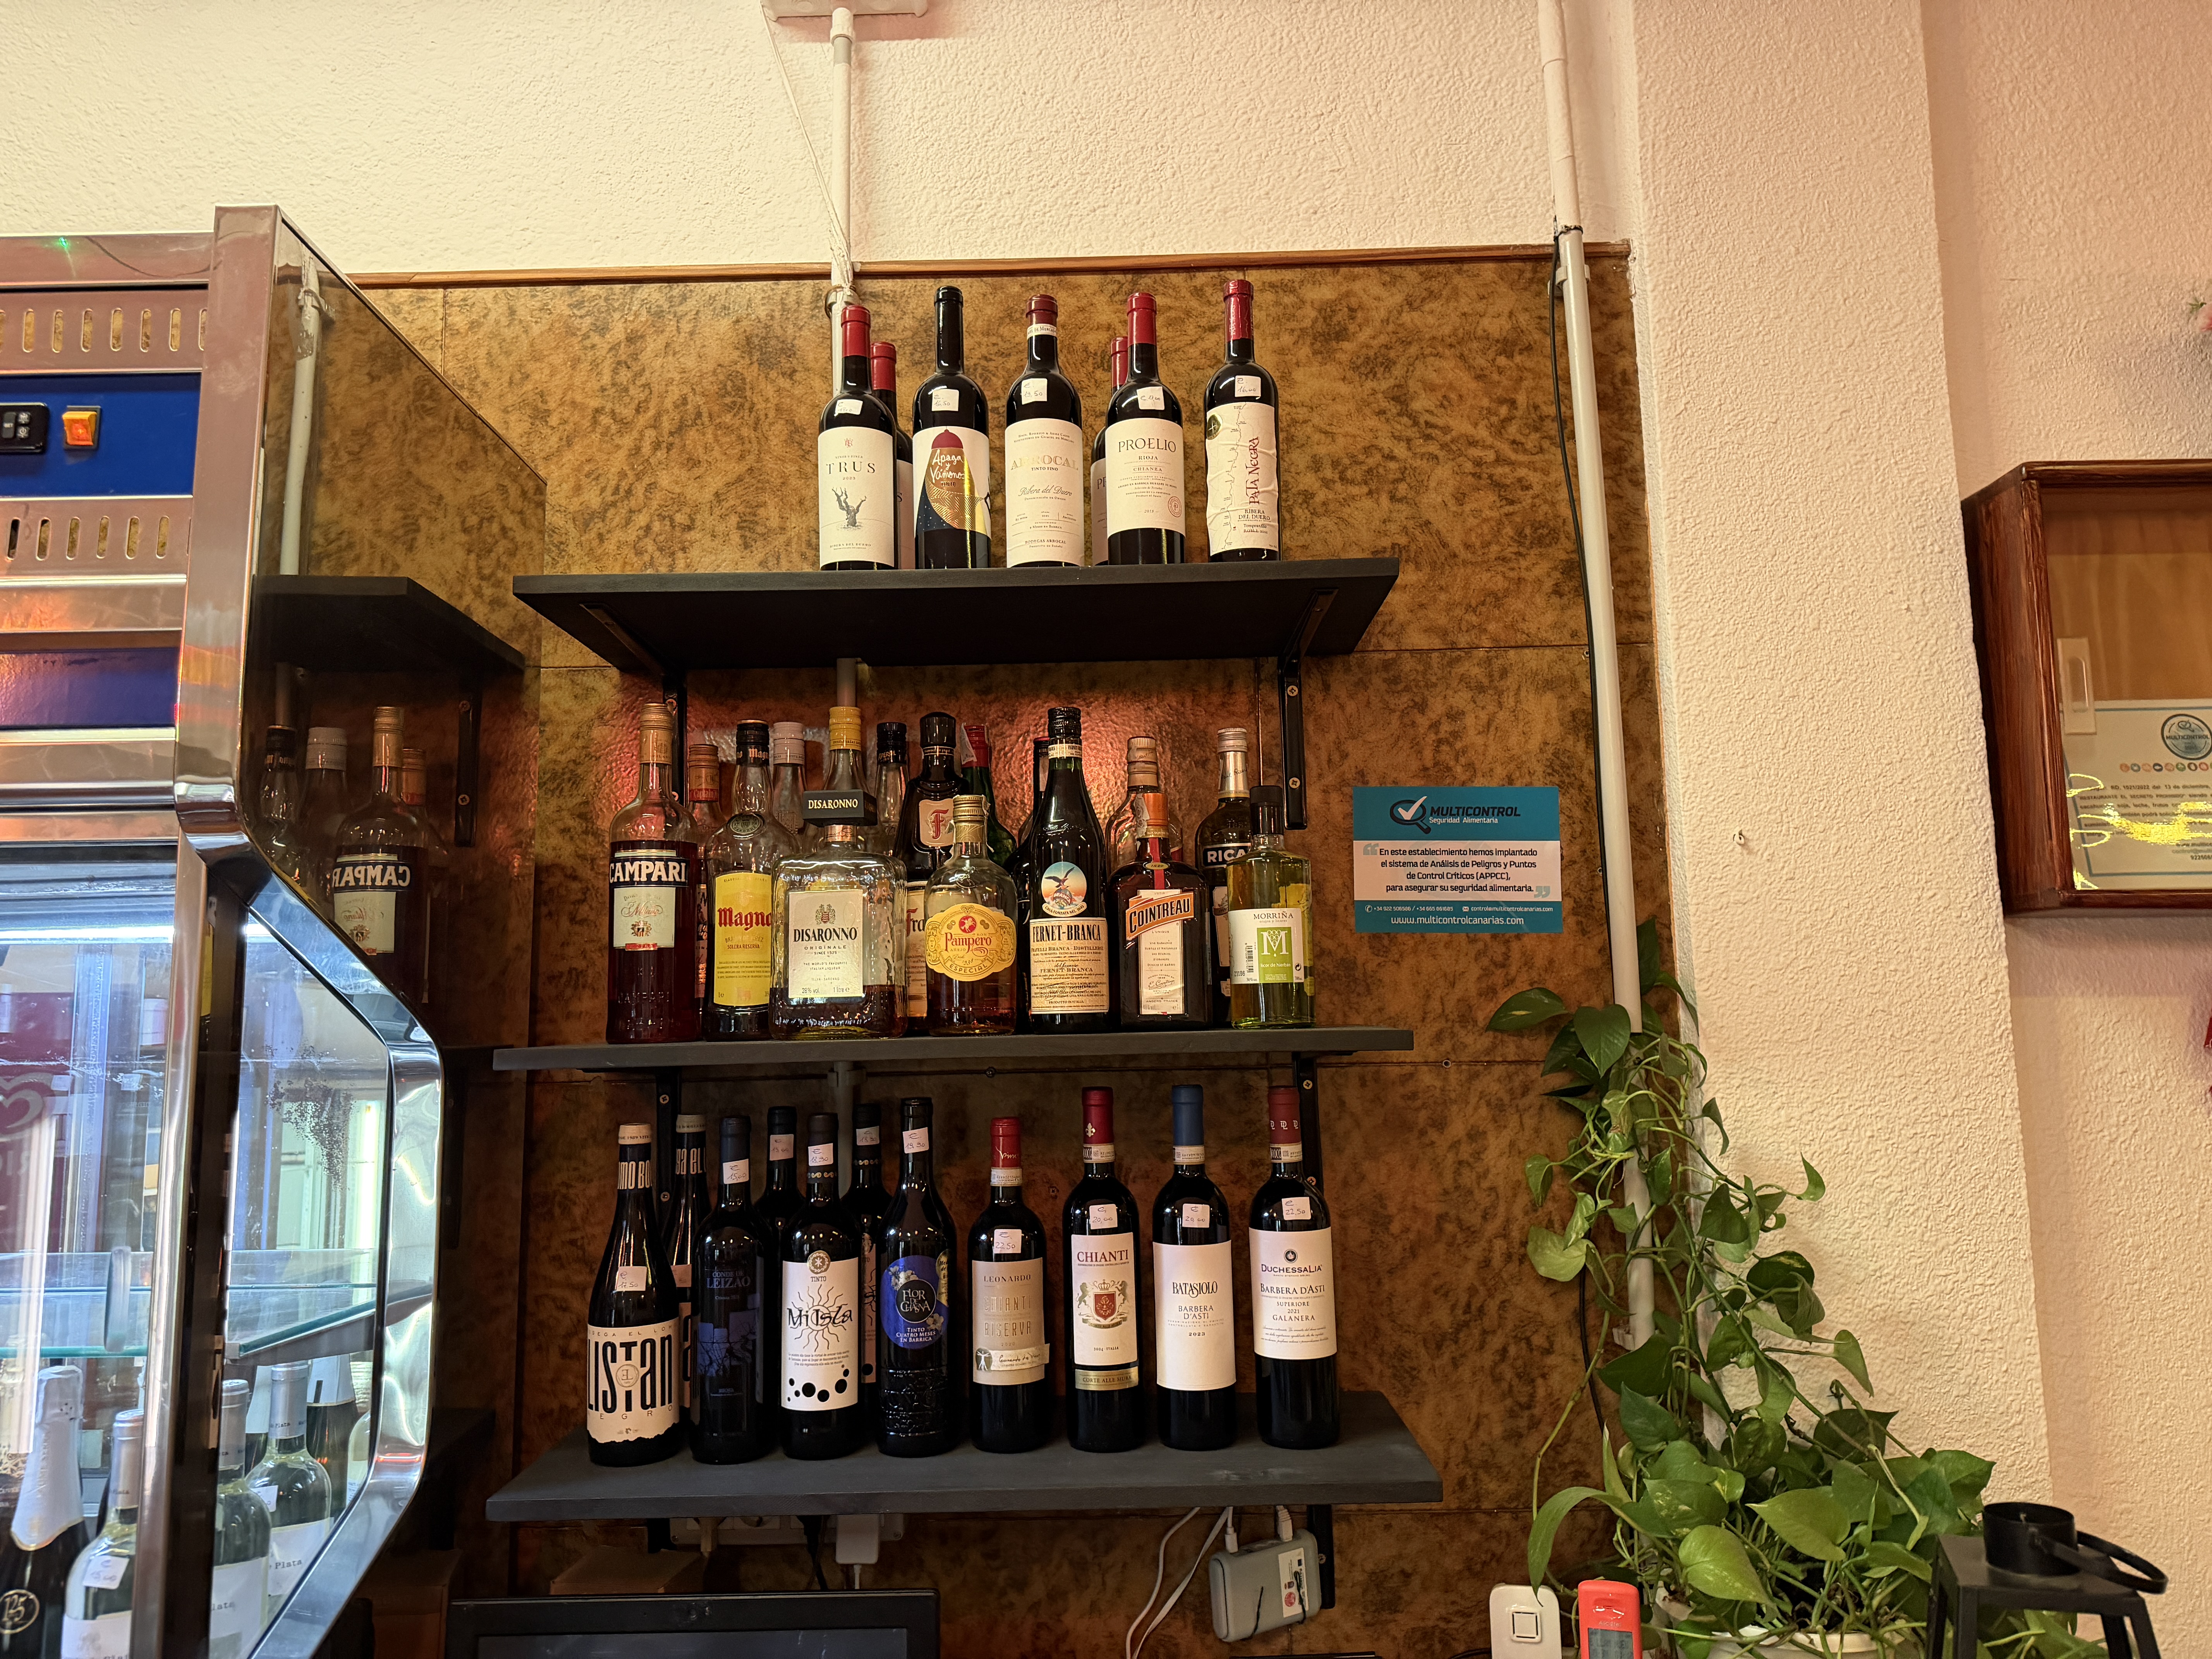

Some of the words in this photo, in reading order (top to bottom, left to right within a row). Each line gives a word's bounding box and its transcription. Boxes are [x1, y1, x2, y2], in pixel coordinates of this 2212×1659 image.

[1118, 438, 1176, 452] PROELIO
[932, 449, 964, 466] Apaga
[826, 461, 875, 474] TRUS
[1018, 486, 1041, 496] Ribera
[1042, 485, 1051, 493] del
[1054, 486, 1072, 496] Duero
[808, 799, 858, 809] DISARONNO
[1430, 806, 1521, 817] MULTICONTROL
[1495, 848, 1537, 857] implantado
[1471, 860, 1502, 869] Peligros
[609, 860, 686, 883] CAMPARI
[1476, 872, 1511, 881] (APPCC),
[1450, 884, 1487, 893] seguridad
[1129, 897, 1191, 934] COINTREAU
[1254, 911, 1294, 920] MORRIÑA
[1391, 915, 1524, 924] www.multicontrolcanarias.com
[793, 927, 858, 942] DISARONNO
[1033, 924, 1101, 942] FERNET-BRANCA
[945, 932, 992, 953] Pampero
[949, 963, 988, 974] ESPECIAL
[727, 1172, 747, 1180] 15,00
[1077, 1249, 1128, 1262] CHIANTI
[984, 1274, 1031, 1283] LEONARDO
[1172, 1281, 1218, 1298] BATASIOLO
[1261, 1283, 1298, 1294] BARBERA
[1300, 1284, 1325, 1294] D'ASTI
[903, 1288, 926, 1302] FLOR
[900, 1301, 931, 1313] CHASNA
[984, 1295, 1031, 1312] CHIANTI
[985, 1321, 1031, 1337] RISERVA
[275, 1558, 302, 1570] Plata
